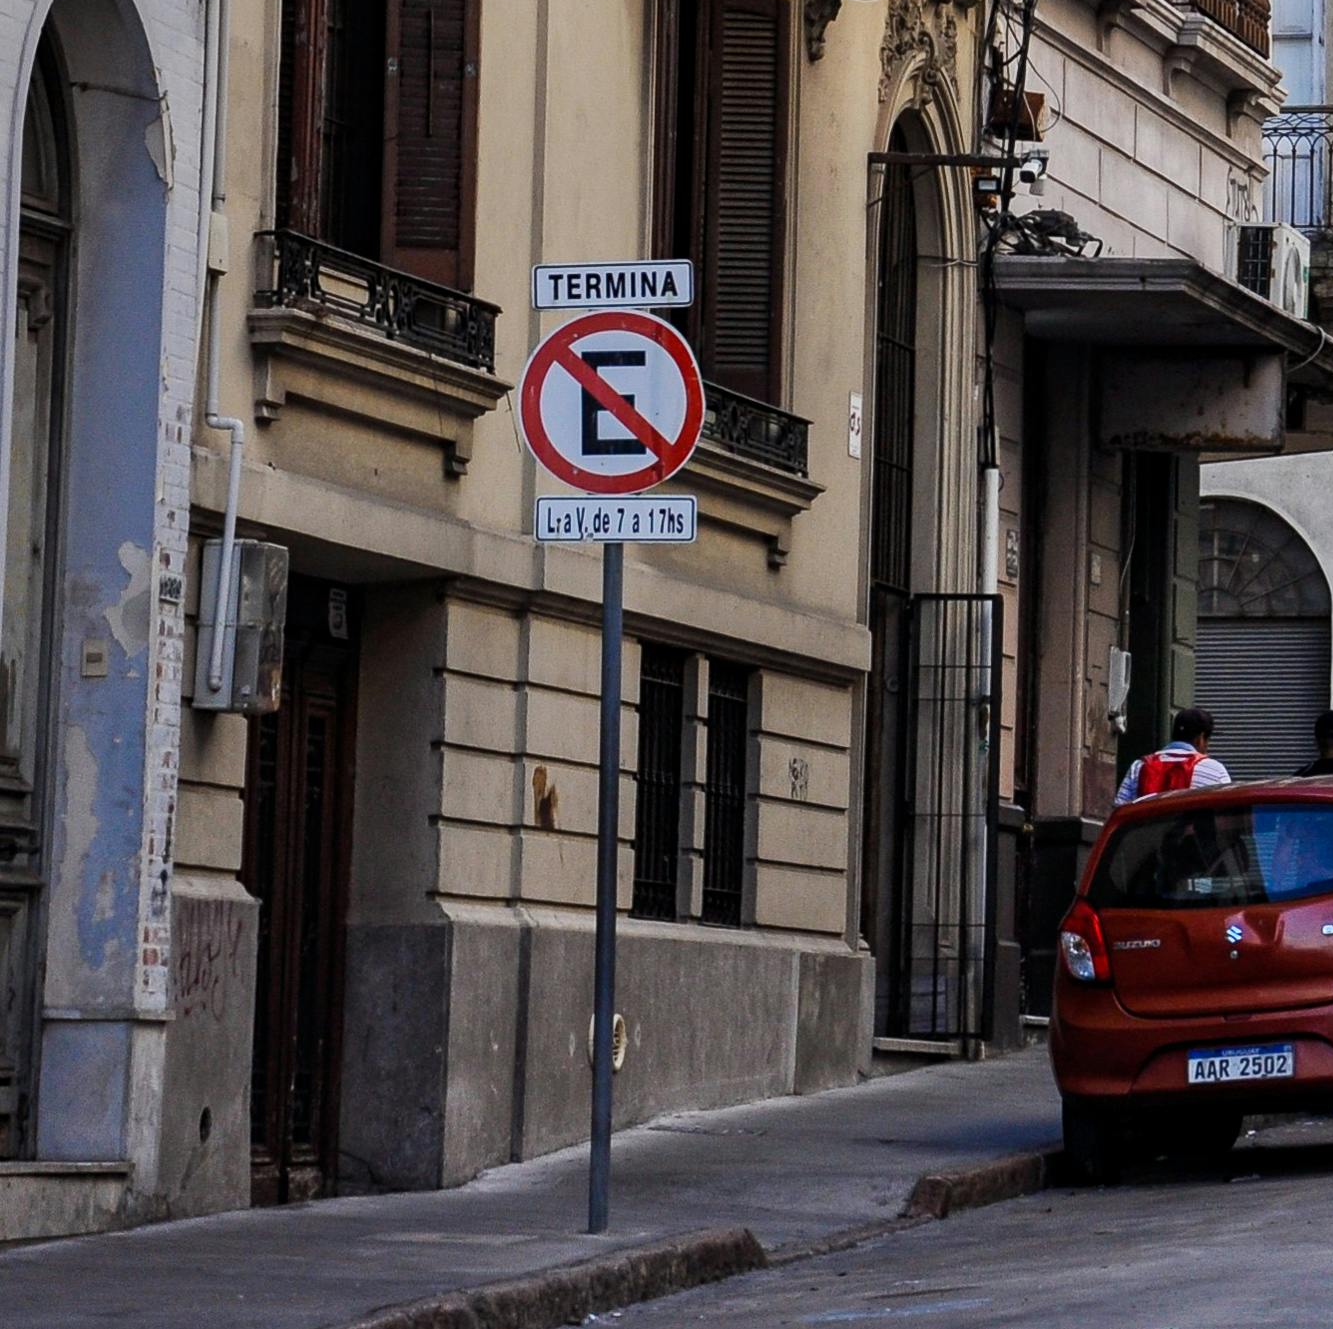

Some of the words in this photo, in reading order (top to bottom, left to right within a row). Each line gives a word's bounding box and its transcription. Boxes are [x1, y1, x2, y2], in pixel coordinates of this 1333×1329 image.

[549, 271, 678, 301] TERMINA
[581, 350, 647, 456] E
[564, 513, 572, 533] a
[593, 507, 610, 533] de
[617, 508, 625, 533] 7
[632, 513, 640, 533] a
[1112, 938, 1161, 950] SUZUKI
[1194, 1059, 1230, 1080] AAR
[1239, 1054, 1288, 1075] 2502
